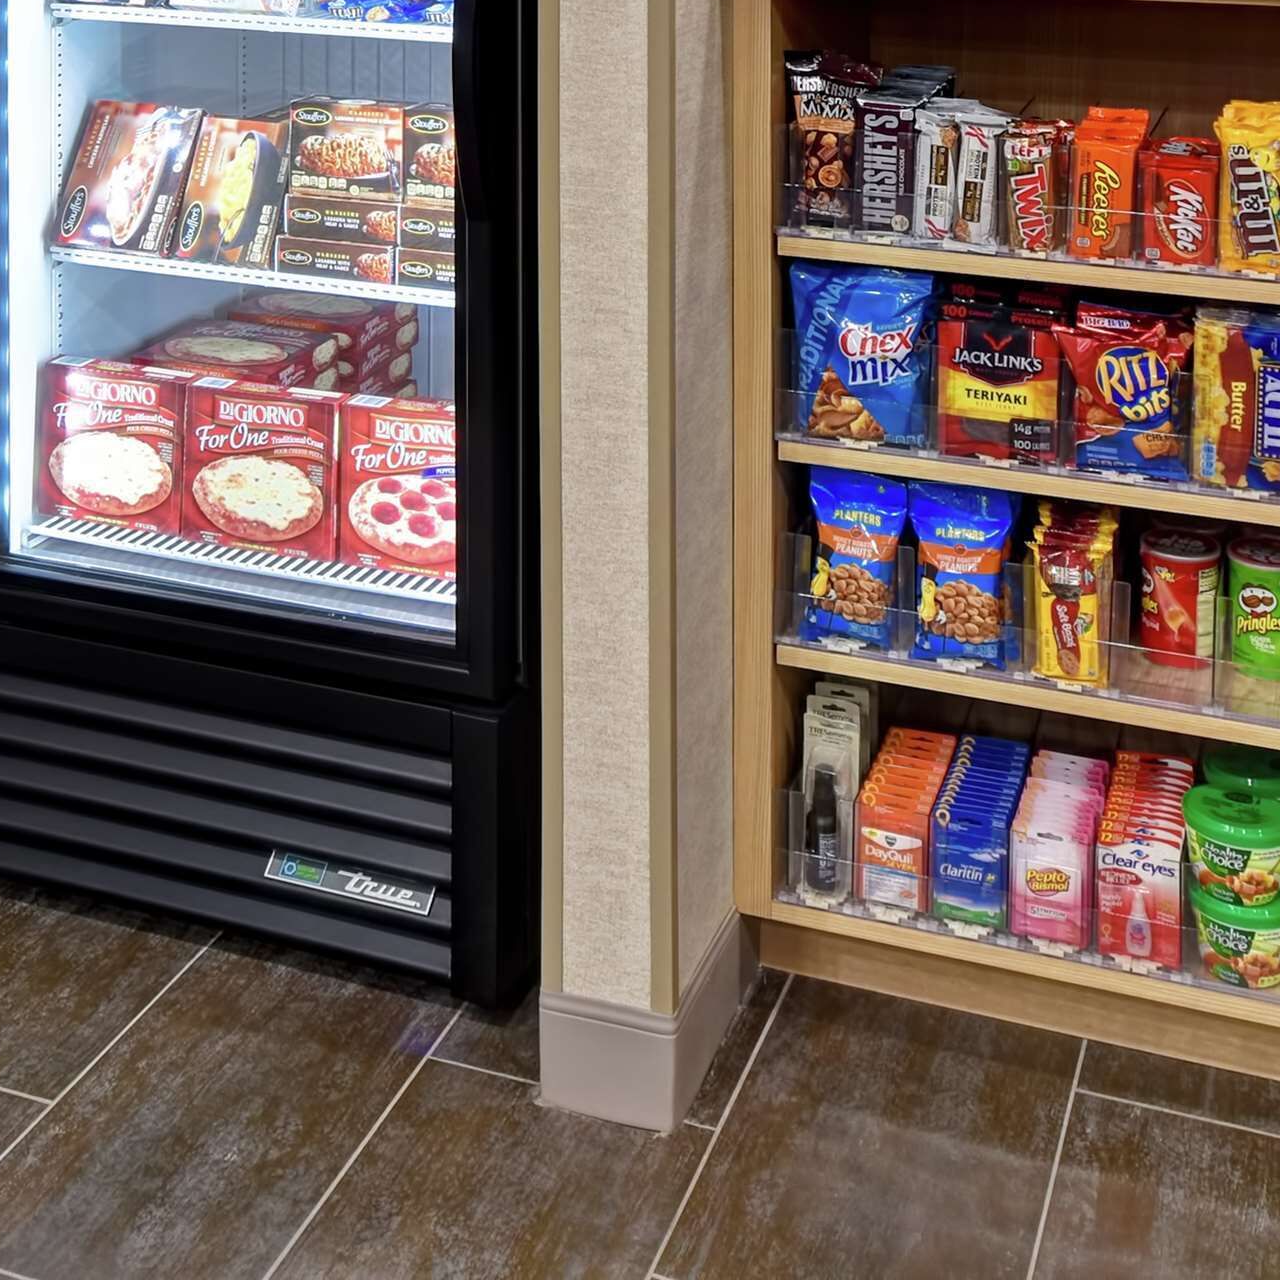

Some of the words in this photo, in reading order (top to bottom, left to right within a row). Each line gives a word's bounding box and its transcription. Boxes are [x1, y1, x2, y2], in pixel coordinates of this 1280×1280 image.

[863, 114, 899, 224] HERSHEY'S
[1011, 164, 1054, 250] TWIX
[840, 323, 914, 357] Chex
[953, 348, 990, 366] JACK
[850, 354, 911, 384] mix
[1098, 350, 1165, 404] RITZ
[965, 388, 1027, 405] TERIYAKI
[1121, 388, 1169, 421] bits
[1231, 381, 1246, 432] Butter
[196, 425, 228, 451] For
[231, 423, 268, 448] One
[1014, 440, 1031, 449] 100
[351, 444, 385, 471] For
[387, 443, 426, 468] One
[835, 510, 881, 526] PLANTERS
[836, 543, 871, 558] PEANUTS
[1101, 833, 1112, 841] 12
[865, 844, 913, 865] DayQuil
[1102, 853, 1140, 868] Clear
[1142, 862, 1175, 877] eyes
[940, 863, 982, 882] Claritin
[1026, 870, 1065, 883] Pepto
[1031, 881, 1069, 892] Bismol
